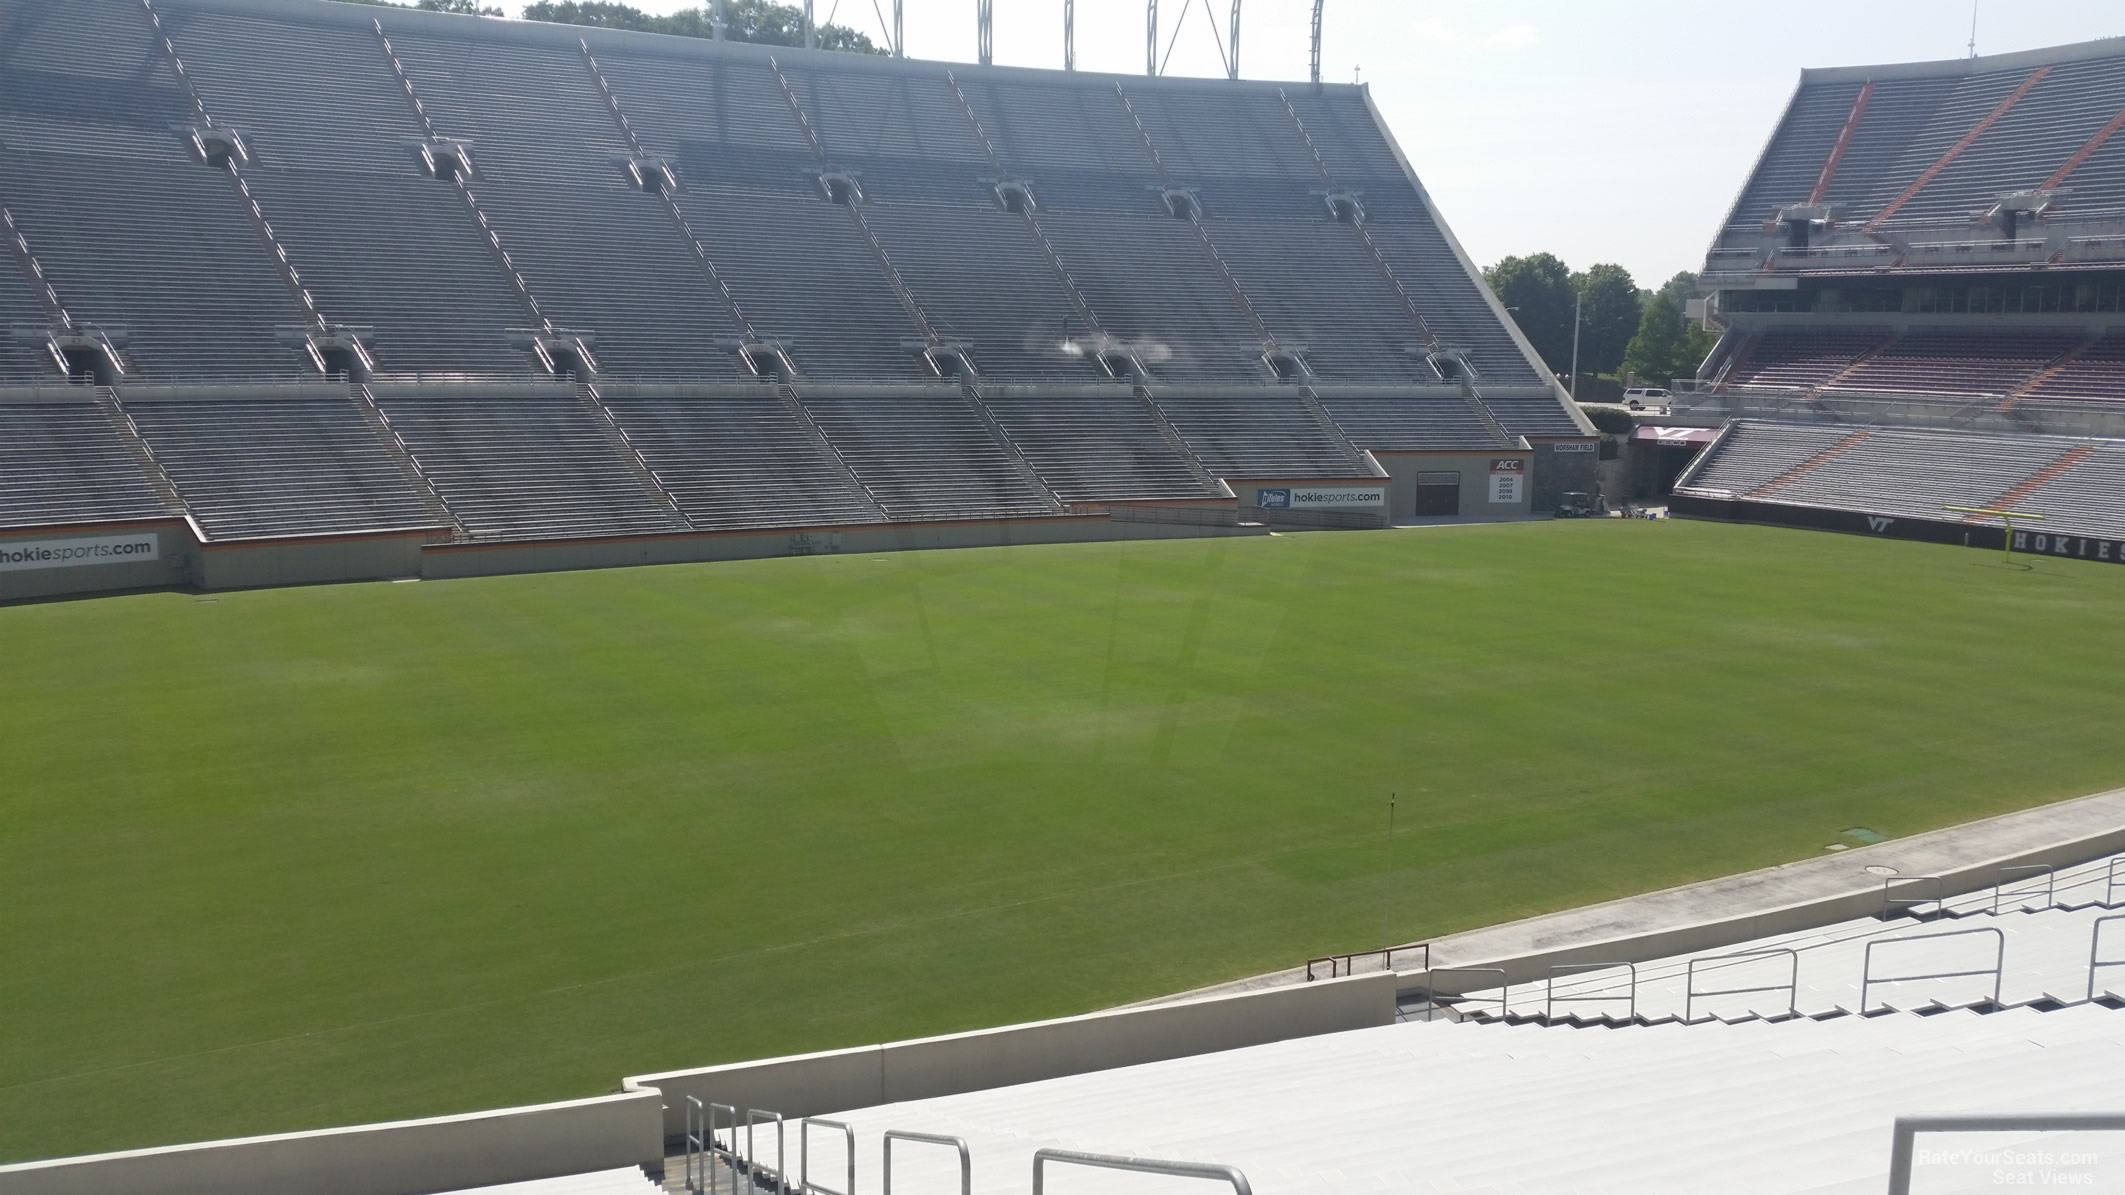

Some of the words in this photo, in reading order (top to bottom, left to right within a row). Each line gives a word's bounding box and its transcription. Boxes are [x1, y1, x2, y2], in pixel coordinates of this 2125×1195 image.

[1555, 443, 1579, 451] WORSHAM
[1580, 443, 1595, 451] FIELD
[1496, 460, 1519, 470] ACC
[1294, 492, 1380, 504] hokiesports.com
[1867, 516, 1895, 533] VT
[0, 542, 151, 563] hokiesports.com
